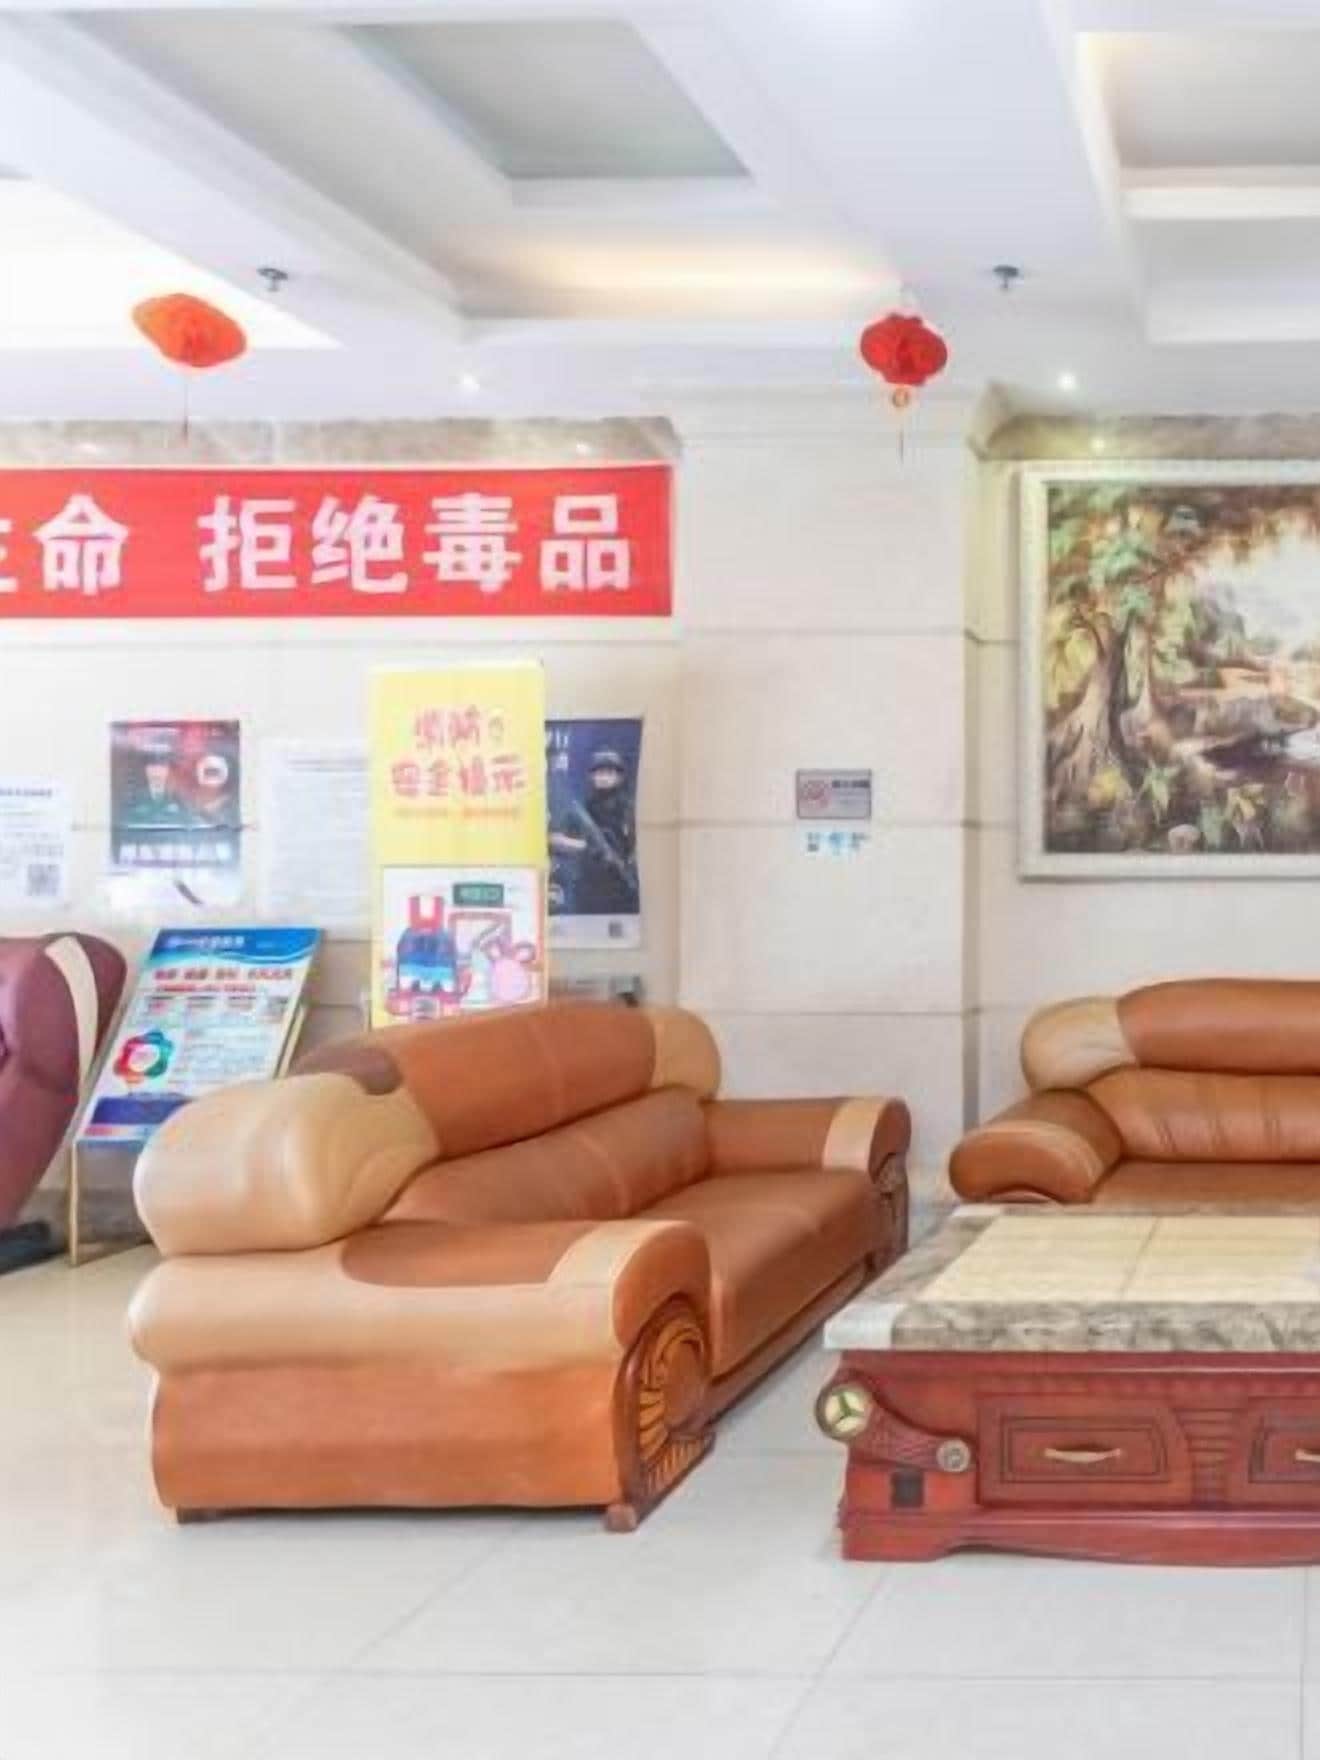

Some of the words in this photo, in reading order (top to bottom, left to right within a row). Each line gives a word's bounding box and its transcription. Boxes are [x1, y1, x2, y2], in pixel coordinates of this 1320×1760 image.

[0, 492, 131, 596] 命
[197, 493, 632, 596] 拒绝毒品
